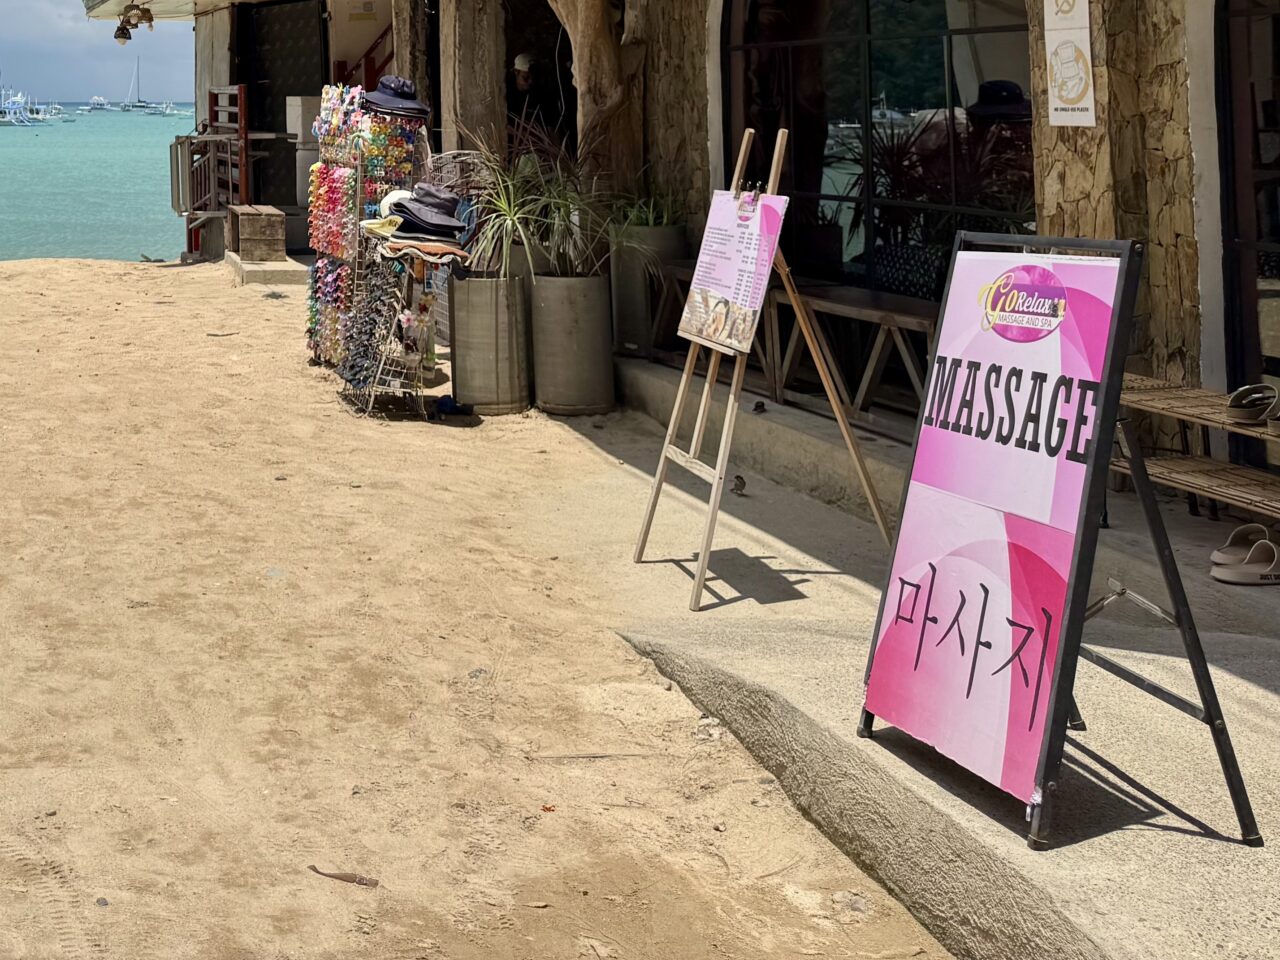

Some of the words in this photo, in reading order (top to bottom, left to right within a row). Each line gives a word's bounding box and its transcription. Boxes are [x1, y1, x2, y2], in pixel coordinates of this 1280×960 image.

[998, 313, 1025, 326] MASSAGE
[1026, 317, 1040, 327] AND
[1040, 318, 1052, 328] SPA
[924, 355, 1101, 465] MASSAGE
[895, 562, 1052, 732] 마사지
